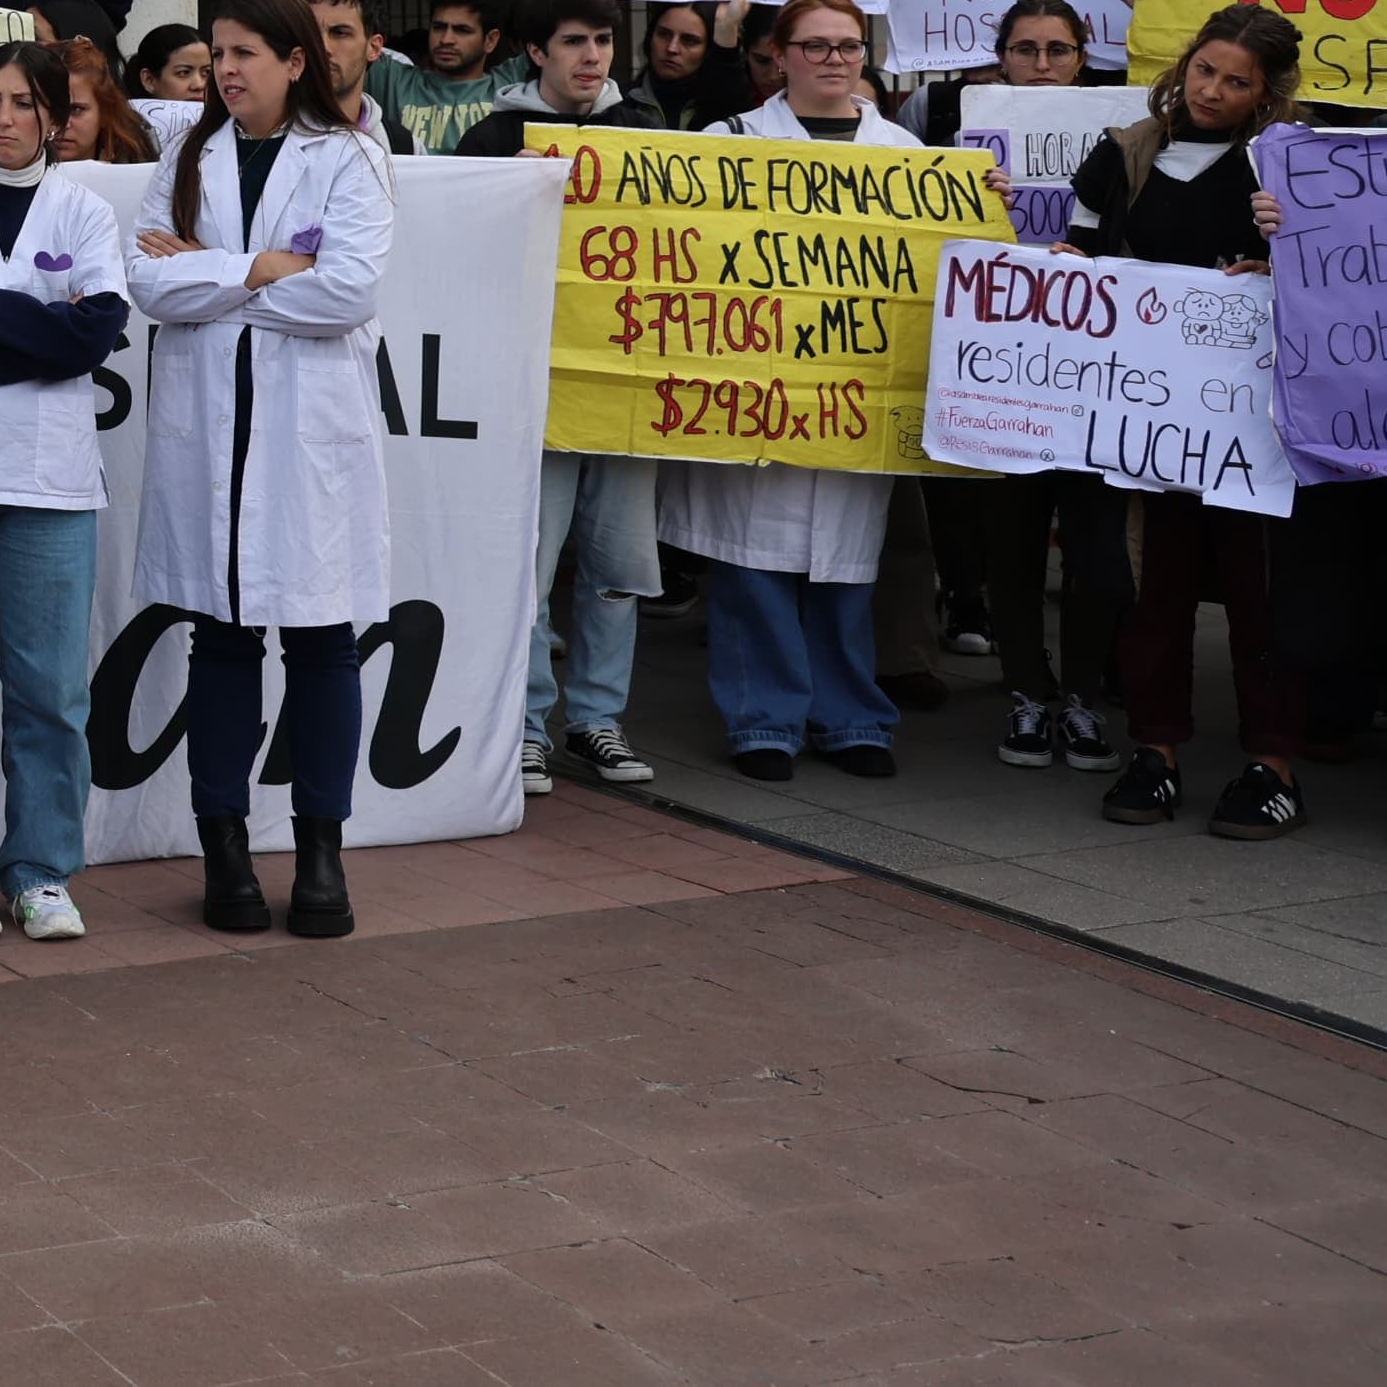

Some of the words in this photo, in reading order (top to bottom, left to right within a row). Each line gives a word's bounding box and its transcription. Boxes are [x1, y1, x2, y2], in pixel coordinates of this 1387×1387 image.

[615, 146, 708, 208] AÑOS
[719, 156, 759, 212] DE
[579, 224, 639, 283] 68
[654, 226, 702, 284] HS
[748, 228, 919, 295] SEMANA
[943, 251, 1119, 339] MÉDICOS
[608, 285, 783, 357] $797.061
[821, 296, 889, 356] MES
[1283, 333, 1309, 380] y
[957, 339, 1171, 407] residentes
[1199, 378, 1255, 415] en
[935, 405, 1054, 439] #FuerzaGarrahan
[1084, 409, 1256, 497] LUCHA
